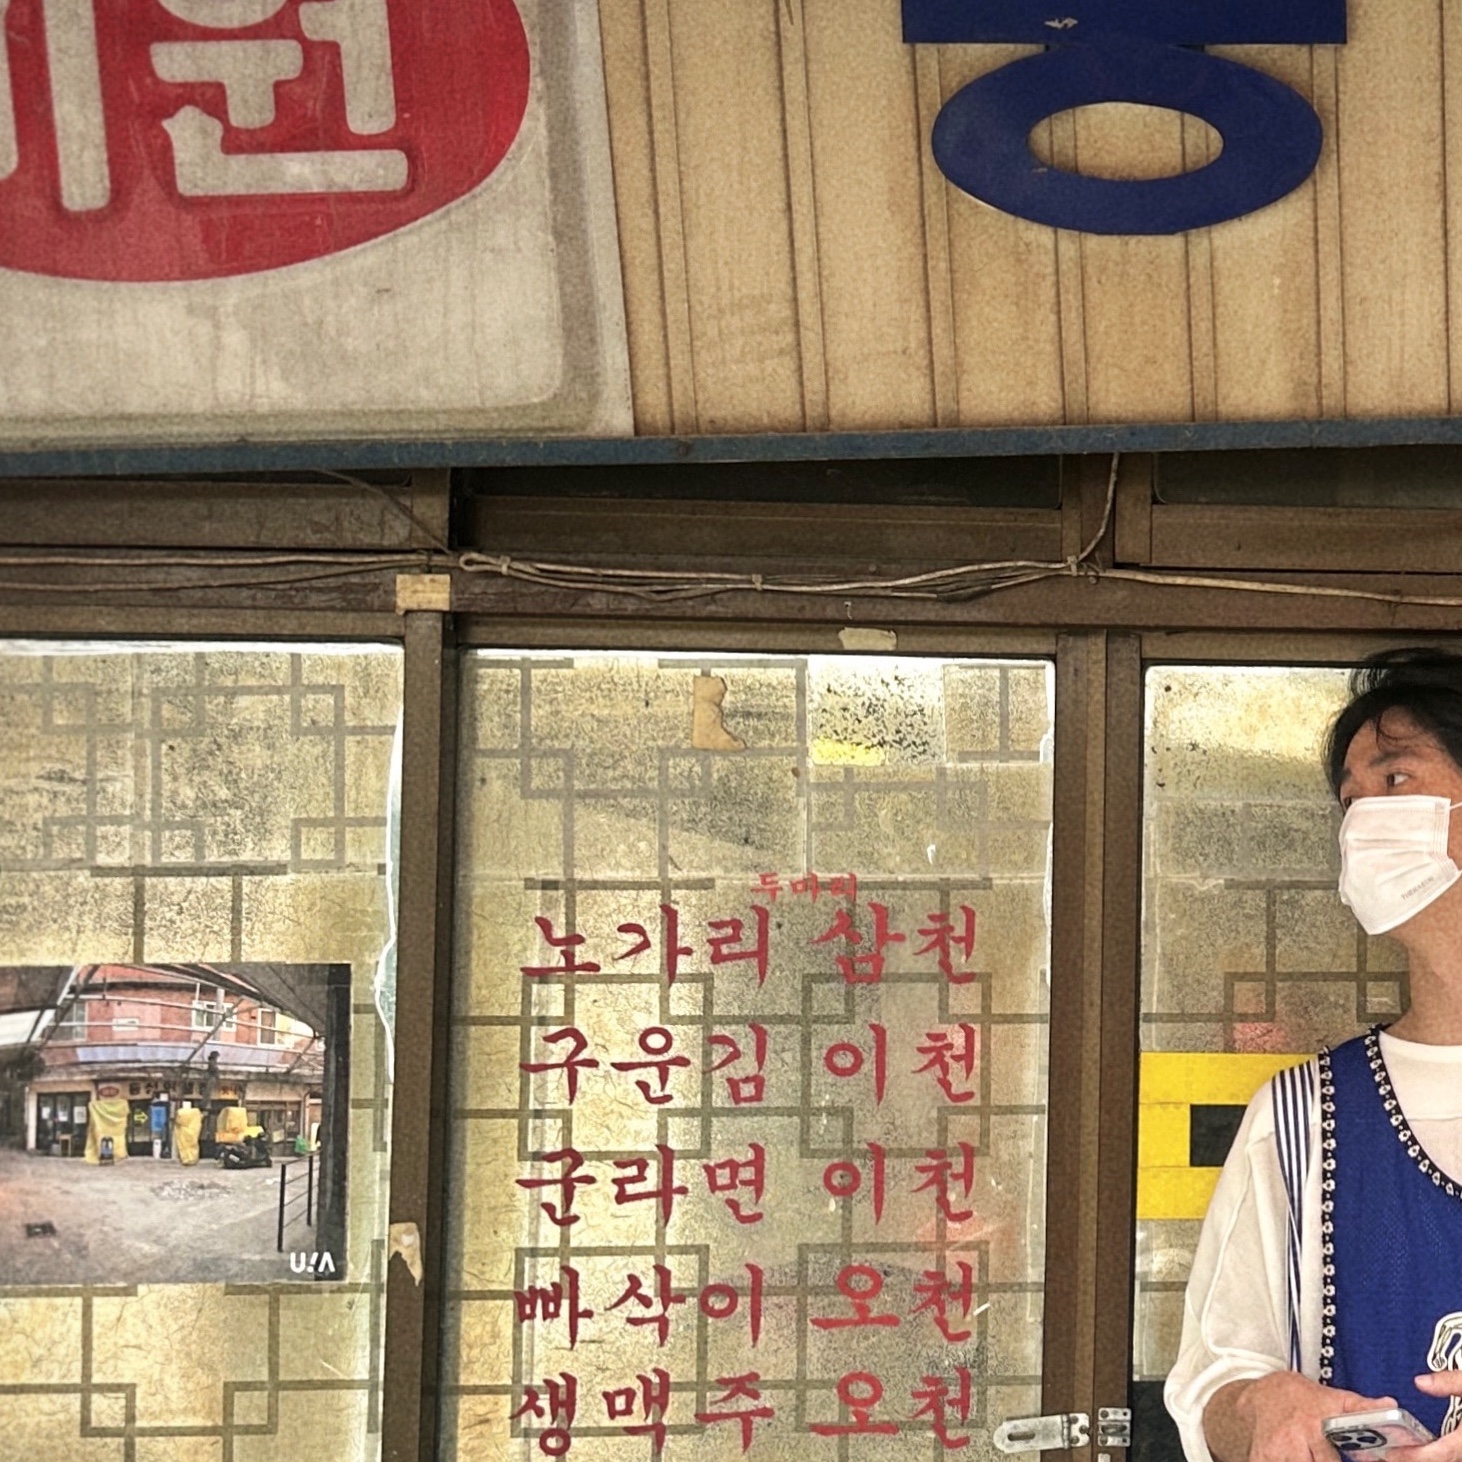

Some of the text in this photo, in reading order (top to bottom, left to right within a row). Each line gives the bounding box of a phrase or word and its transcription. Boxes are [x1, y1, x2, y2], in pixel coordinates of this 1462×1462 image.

[750, 871, 857, 906] 두마리
[520, 903, 977, 987] 노가리 삼천
[520, 1022, 977, 1106] 구운김 이천
[515, 1141, 976, 1227] 군라면 이천
[513, 1259, 974, 1350] 빠삭이 오천
[509, 1366, 972, 1457] 생맥주 오천
